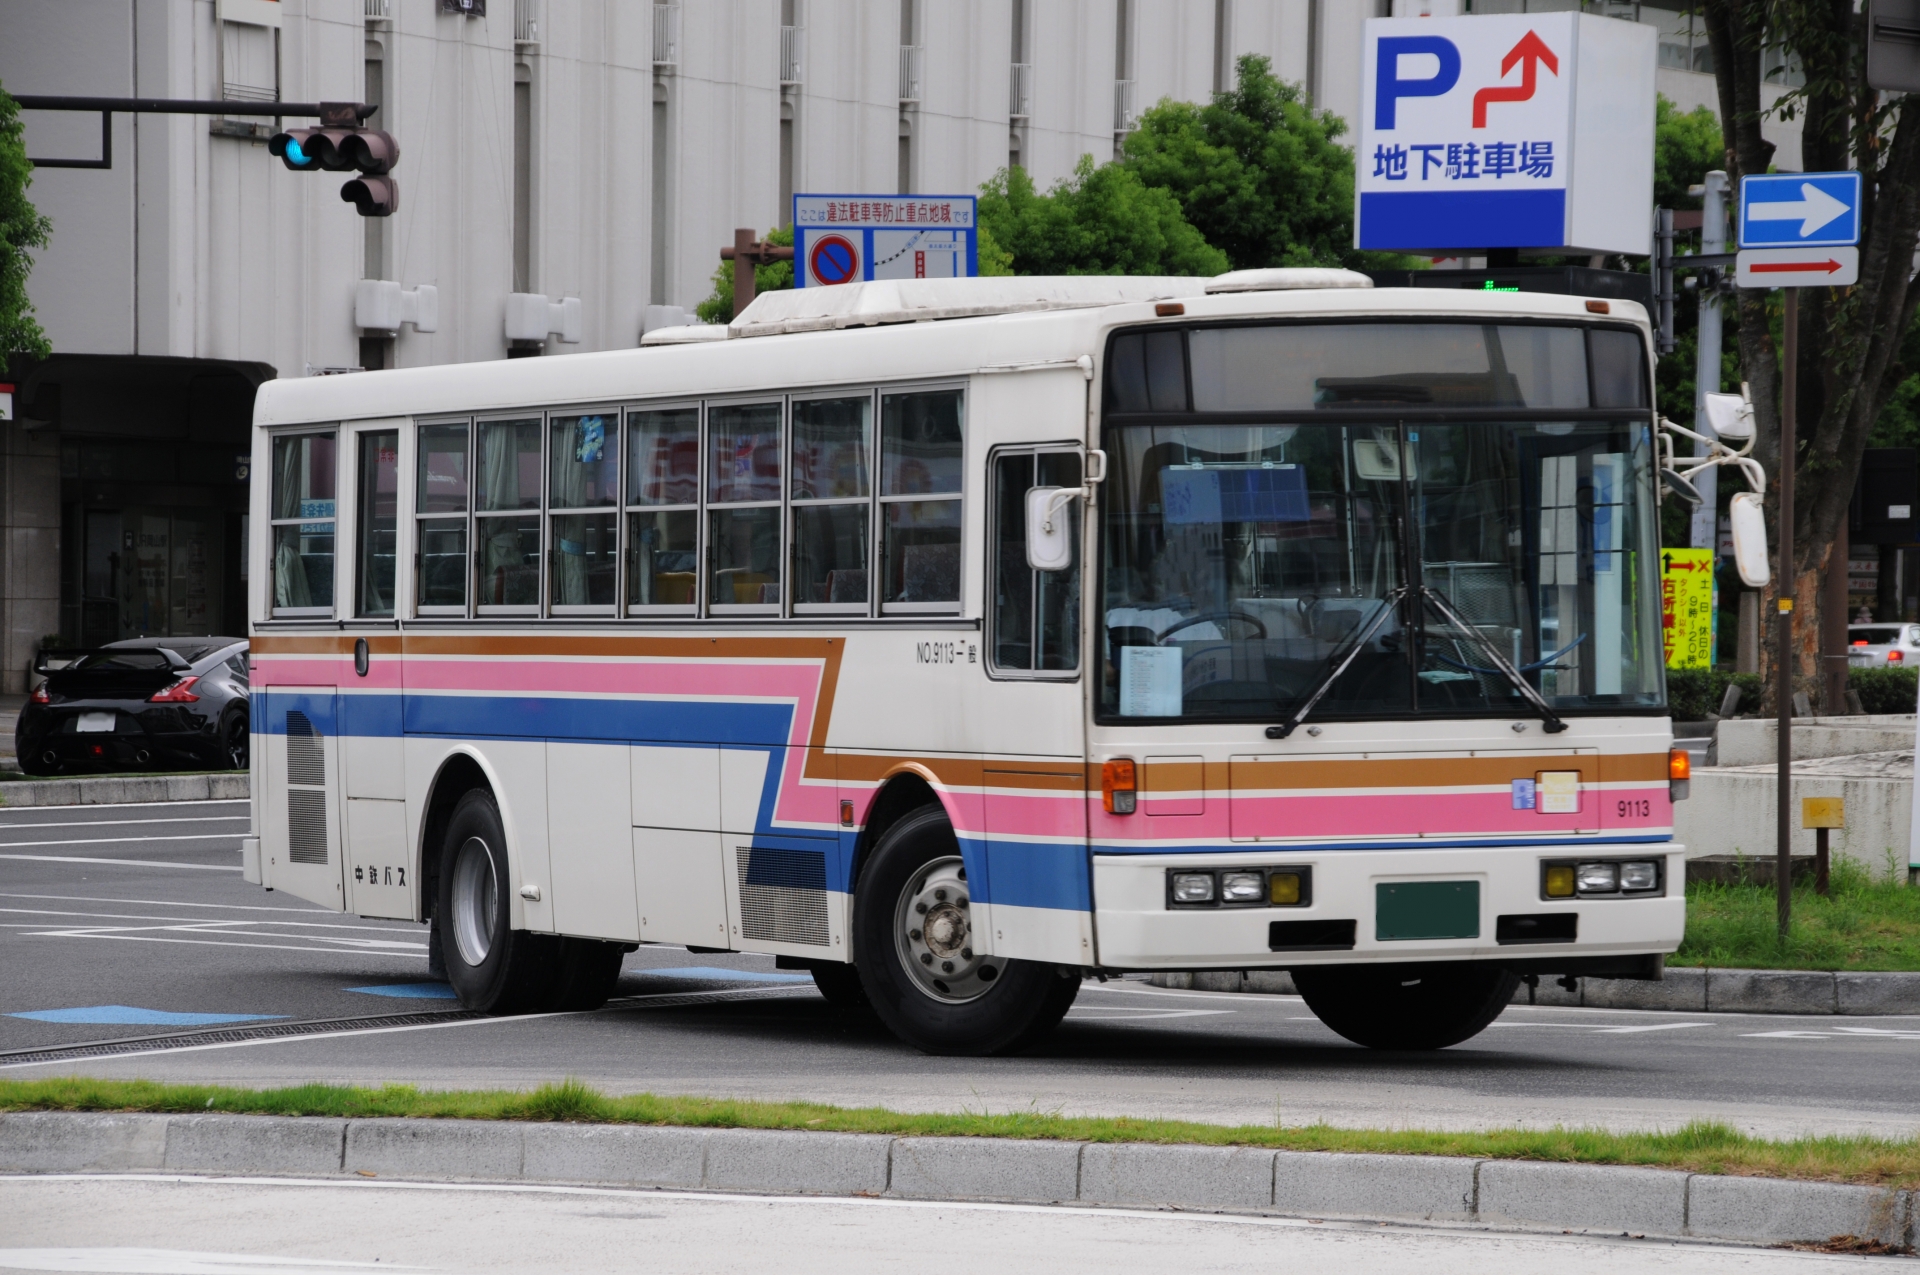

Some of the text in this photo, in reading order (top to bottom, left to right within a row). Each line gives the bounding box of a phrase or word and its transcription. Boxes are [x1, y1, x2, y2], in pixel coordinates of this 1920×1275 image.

[1375, 35, 1462, 130] P
[1373, 141, 1555, 180] 地下駐車場
[801, 201, 970, 223] ここは違法駐車等防止重点地域です
[1618, 800, 1650, 818] 9113
[355, 864, 406, 887] 中鉄バス
